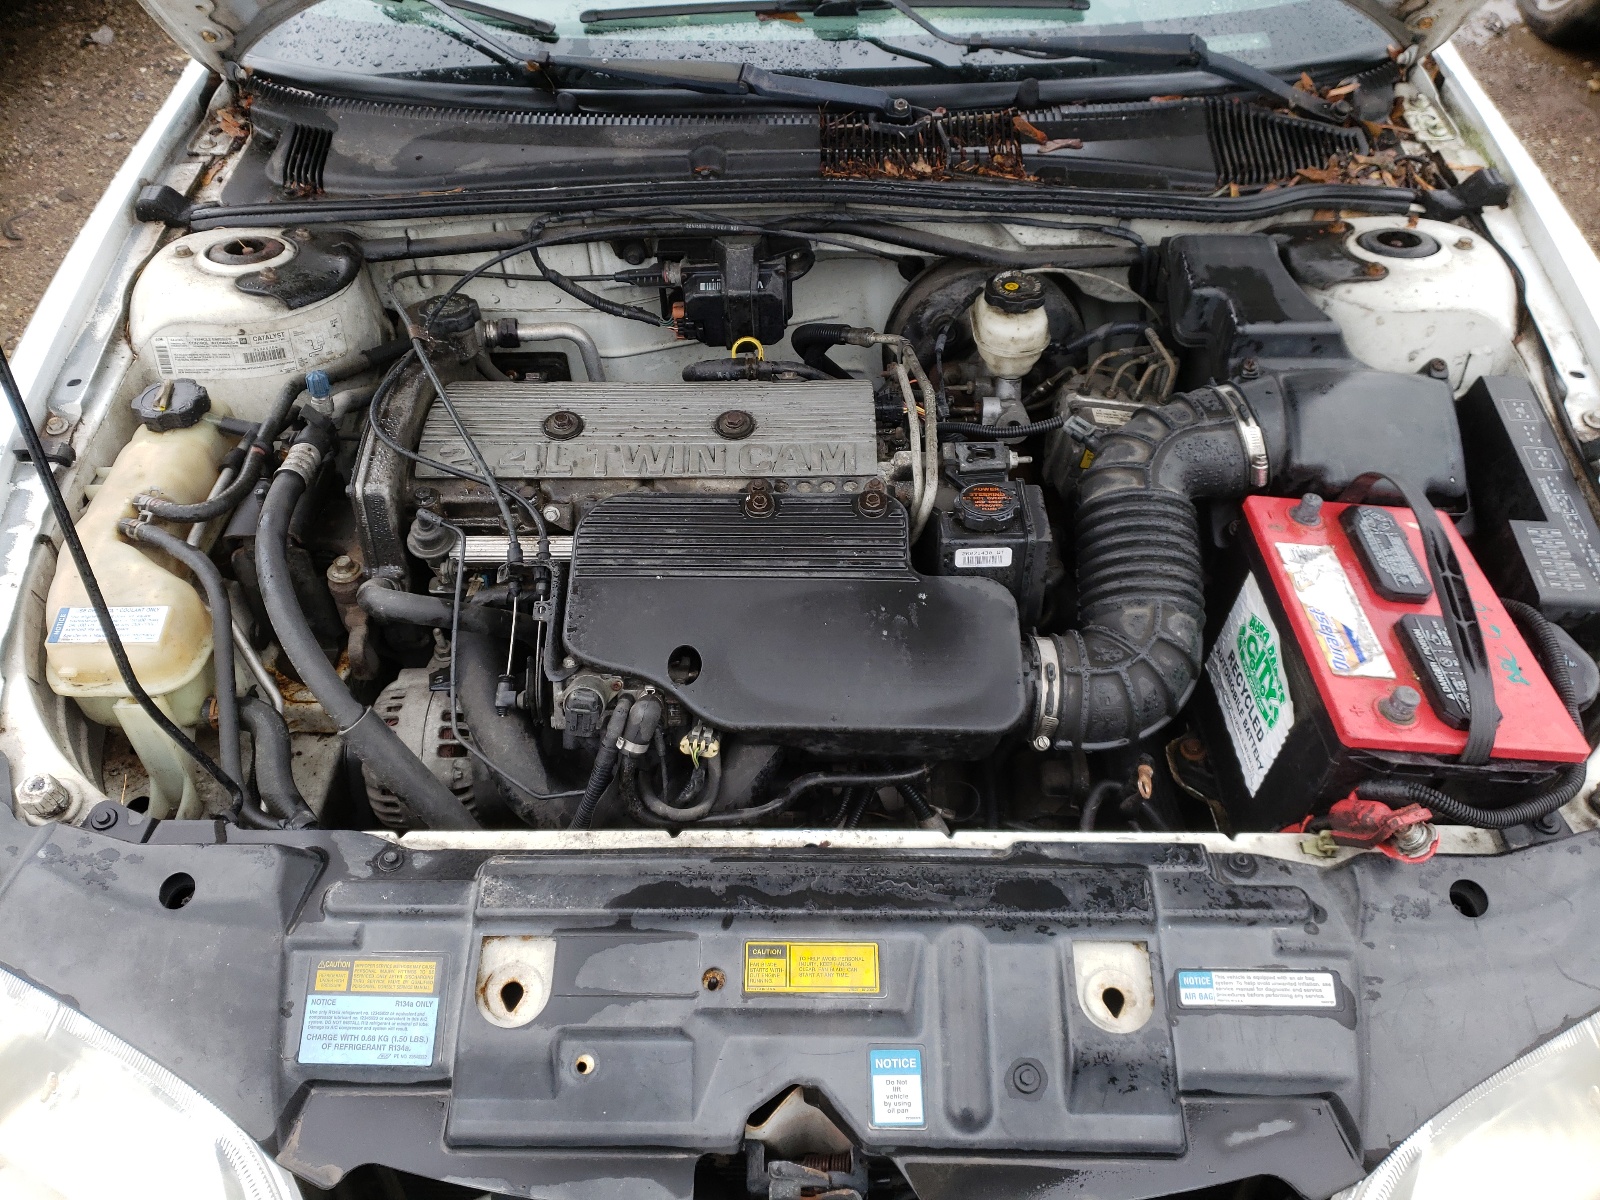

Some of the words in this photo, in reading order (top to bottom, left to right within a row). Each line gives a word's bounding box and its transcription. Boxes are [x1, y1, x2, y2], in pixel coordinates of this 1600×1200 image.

[253, 332, 284, 341] CATALYST
[587, 444, 727, 476] TWIN
[739, 443, 857, 475] CAM
[53, 613, 66, 635] NOTICE
[1248, 612, 1271, 644] AUTO
[1308, 606, 1351, 673] Duralast
[1246, 632, 1278, 700] CITY
[1215, 648, 1245, 719] AUTOMOBILE
[1227, 648, 1265, 744] RECYCLED
[1183, 977, 1211, 985] NOTICE
[1185, 992, 1196, 1000] AIR
[391, 1035, 408, 1043] (1.50
[410, 1036, 429, 1044] LBS.)
[875, 1058, 917, 1069] NOTICE
